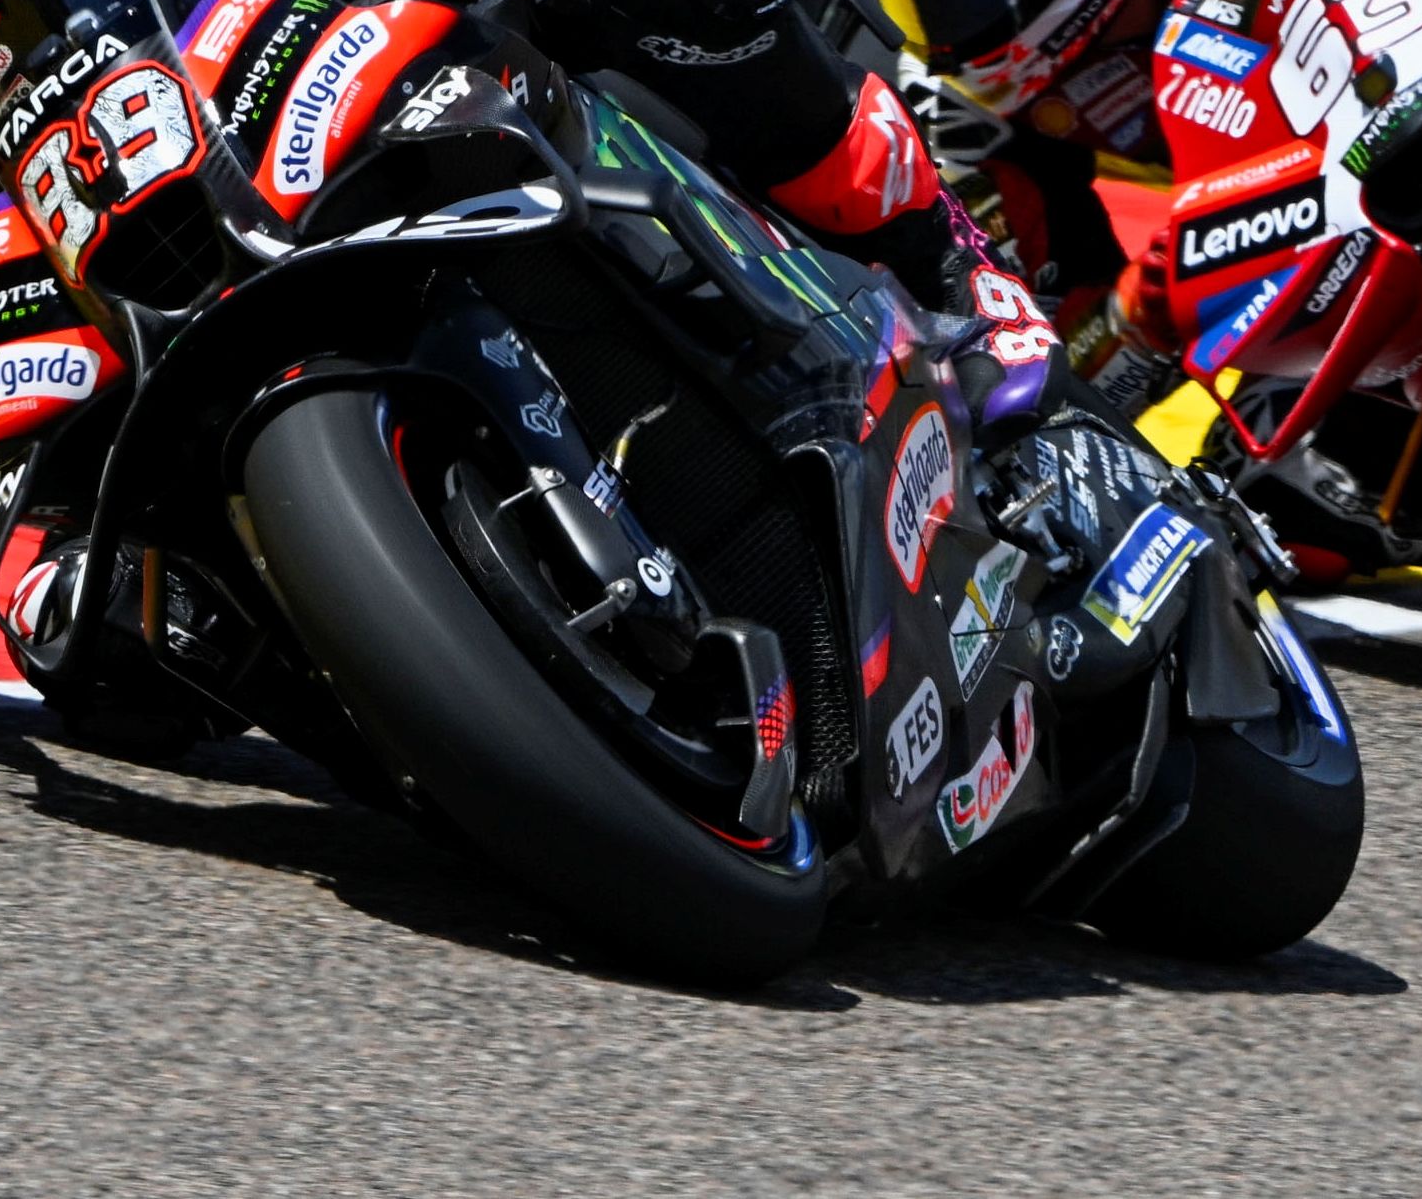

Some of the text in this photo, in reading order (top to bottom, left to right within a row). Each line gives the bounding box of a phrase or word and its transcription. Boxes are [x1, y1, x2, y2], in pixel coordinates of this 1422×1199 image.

[220, 12, 307, 137] MONSTER
[251, 33, 302, 121] ENERGY
[284, 23, 376, 185] sterilgarda
[330, 79, 363, 140] alimenti
[400, 66, 472, 132] sky
[1183, 74, 1259, 140] riello
[17, 59, 207, 288] 89
[1182, 196, 1320, 268] Lenovo
[1306, 230, 1372, 314] CARRERA
[1231, 278, 1280, 334] TIM
[894, 413, 950, 562] sterilgarda
